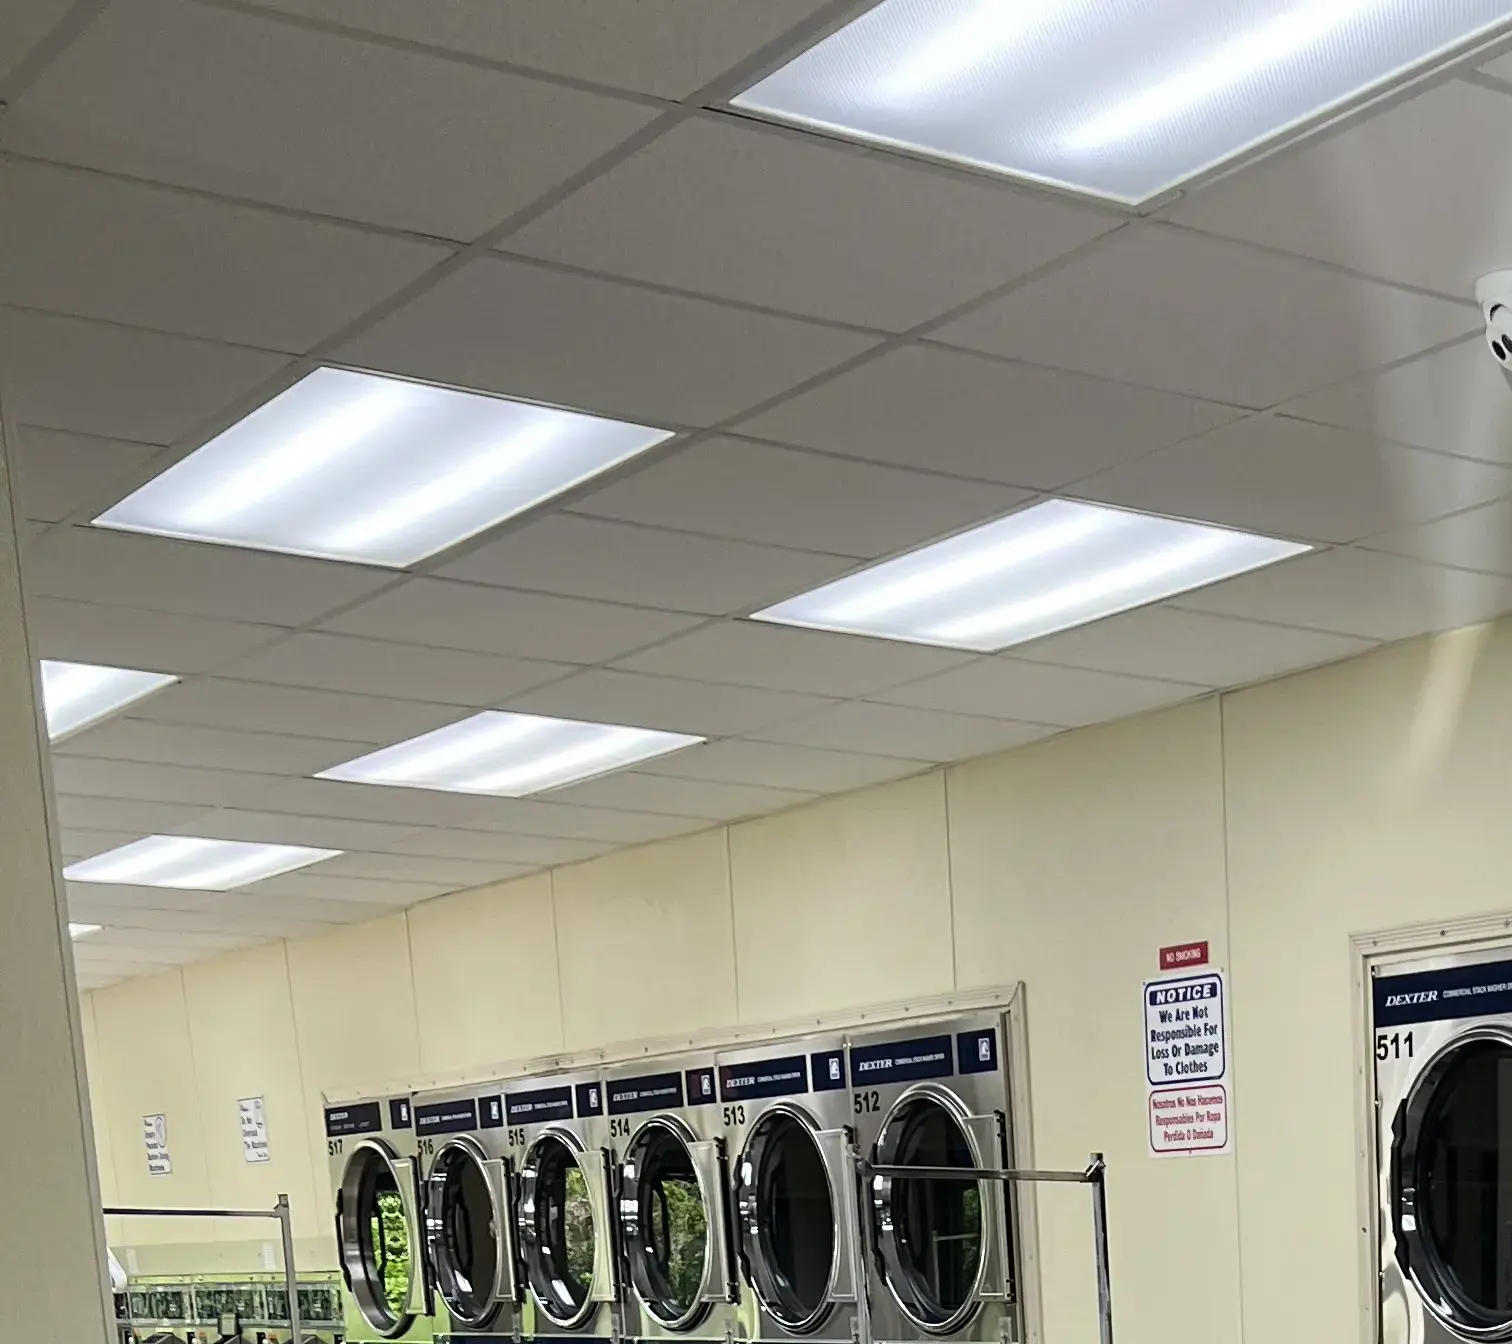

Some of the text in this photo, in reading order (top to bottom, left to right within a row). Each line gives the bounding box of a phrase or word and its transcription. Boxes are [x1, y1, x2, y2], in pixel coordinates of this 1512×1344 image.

[1156, 984, 1212, 1005] NOTICE
[1385, 990, 1438, 1007] DEXTER
[1159, 1006, 1208, 1023] We Are Not
[1151, 1022, 1218, 1044] Responsible For
[1151, 1042, 1219, 1060] Loss Or Damage
[1376, 1031, 1413, 1060] 511
[858, 1058, 893, 1071] DEXTER
[1163, 1060, 1208, 1076] To Clothes
[854, 1090, 880, 1114] 512
[723, 1105, 745, 1126] 513
[610, 1117, 630, 1137] 514
[508, 1128, 525, 1146] 515
[328, 1139, 343, 1156] 517
[417, 1138, 434, 1155] 516
